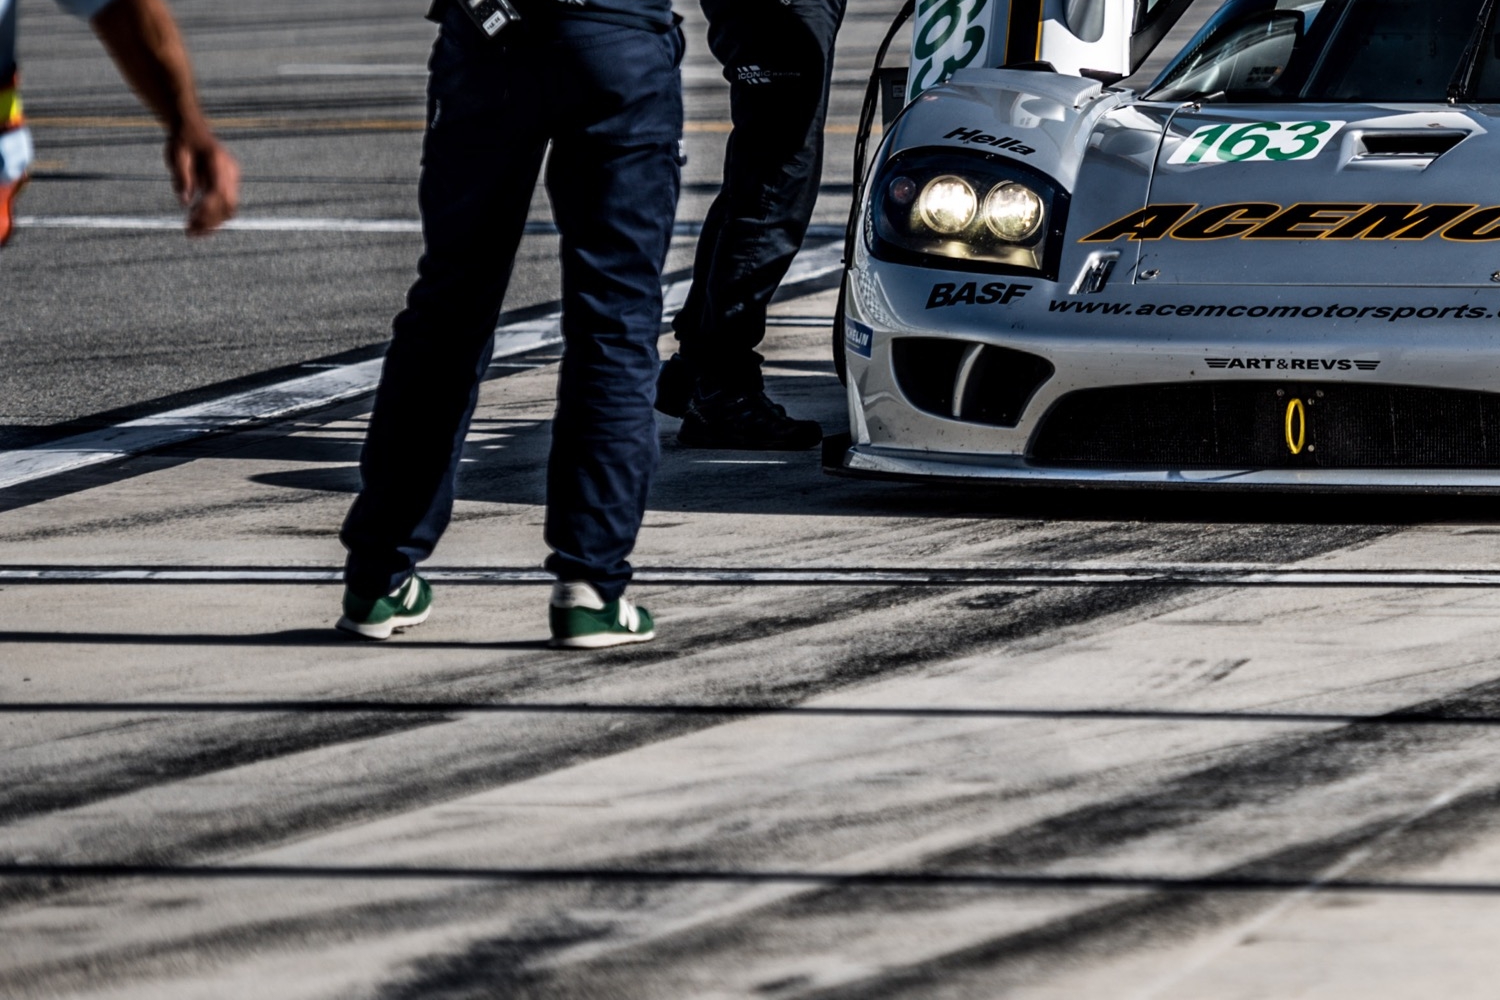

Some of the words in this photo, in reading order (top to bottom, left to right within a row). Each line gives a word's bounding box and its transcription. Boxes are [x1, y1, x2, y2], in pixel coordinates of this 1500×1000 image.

[737, 69, 771, 80] ICONIC
[942, 127, 1037, 156] Hella
[1189, 120, 1331, 163] 163
[925, 281, 1033, 310] BASF
[1228, 357, 1353, 371] ART&REVS
